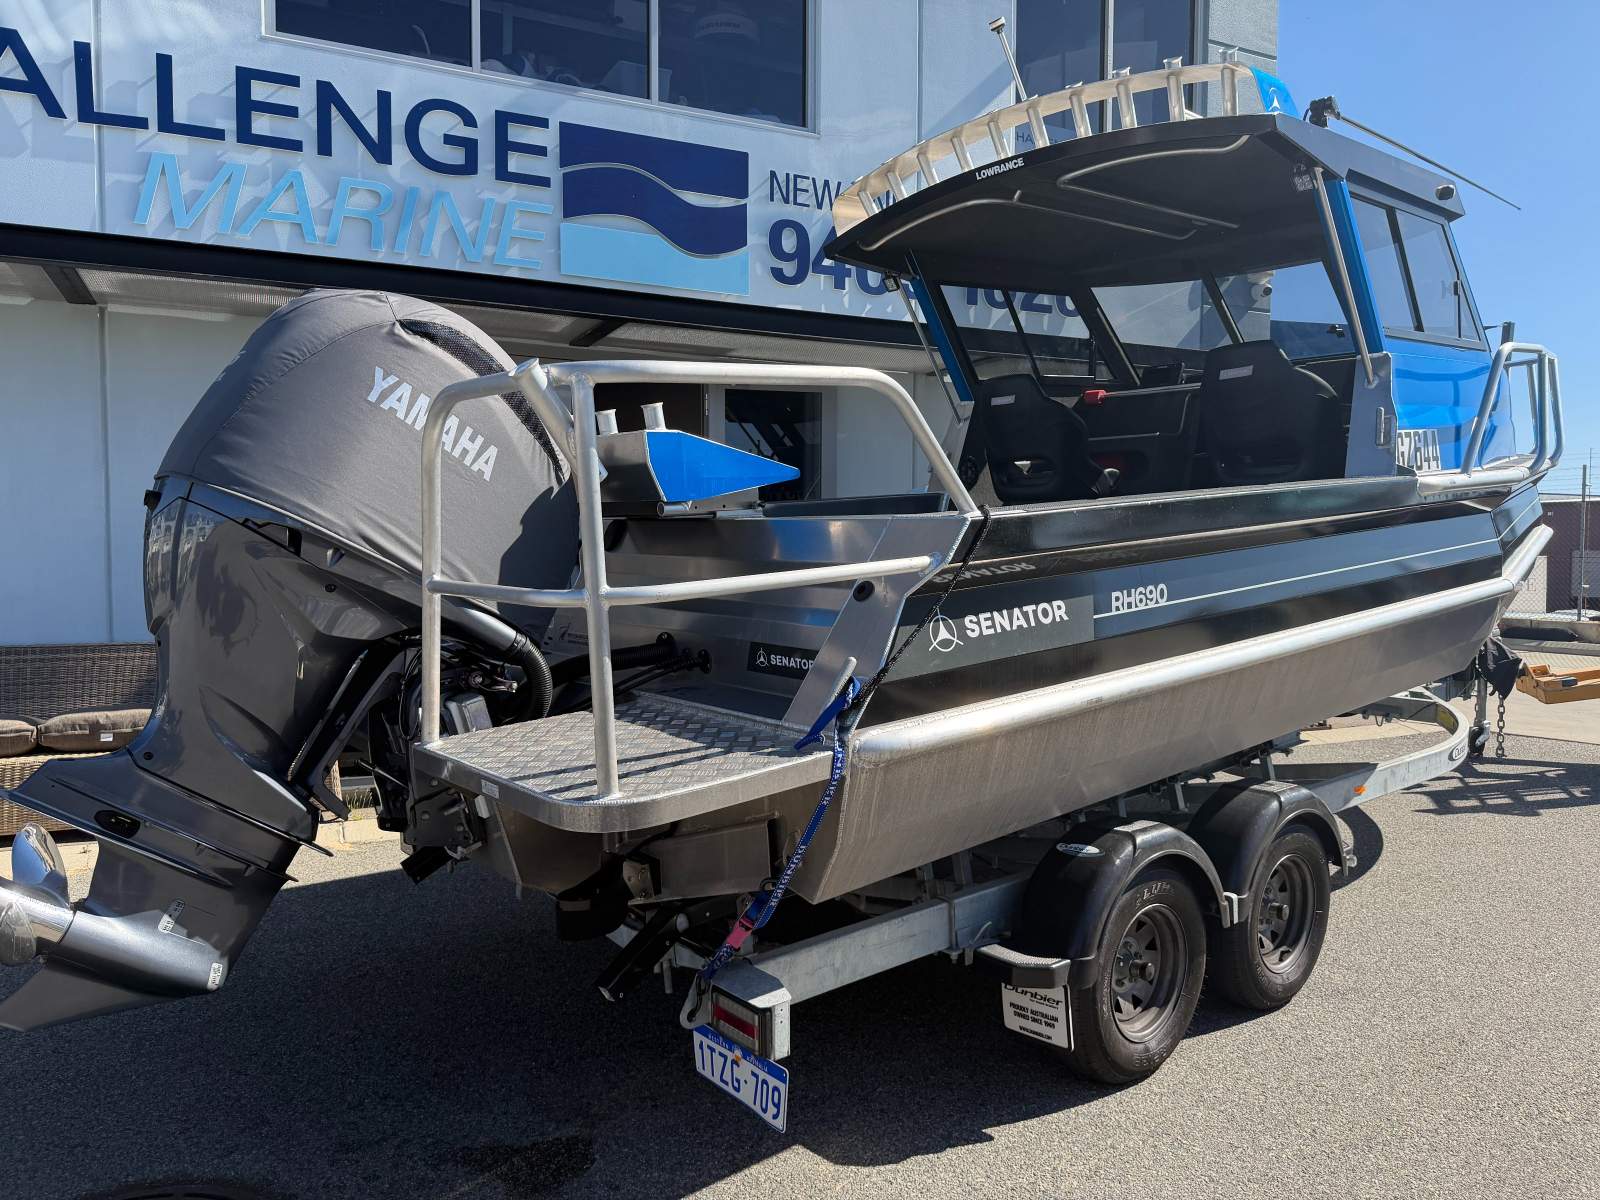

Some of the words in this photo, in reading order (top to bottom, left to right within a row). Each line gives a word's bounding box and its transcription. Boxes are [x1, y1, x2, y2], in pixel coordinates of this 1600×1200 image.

[0, 26, 552, 190] ALLENGE
[975, 157, 1025, 180] LOWRANCE
[132, 151, 555, 270] MARINE
[769, 170, 842, 211] NEW
[367, 366, 498, 482] YAMAHA
[964, 600, 1069, 638] SENATOR
[1111, 584, 1168, 613] RH690
